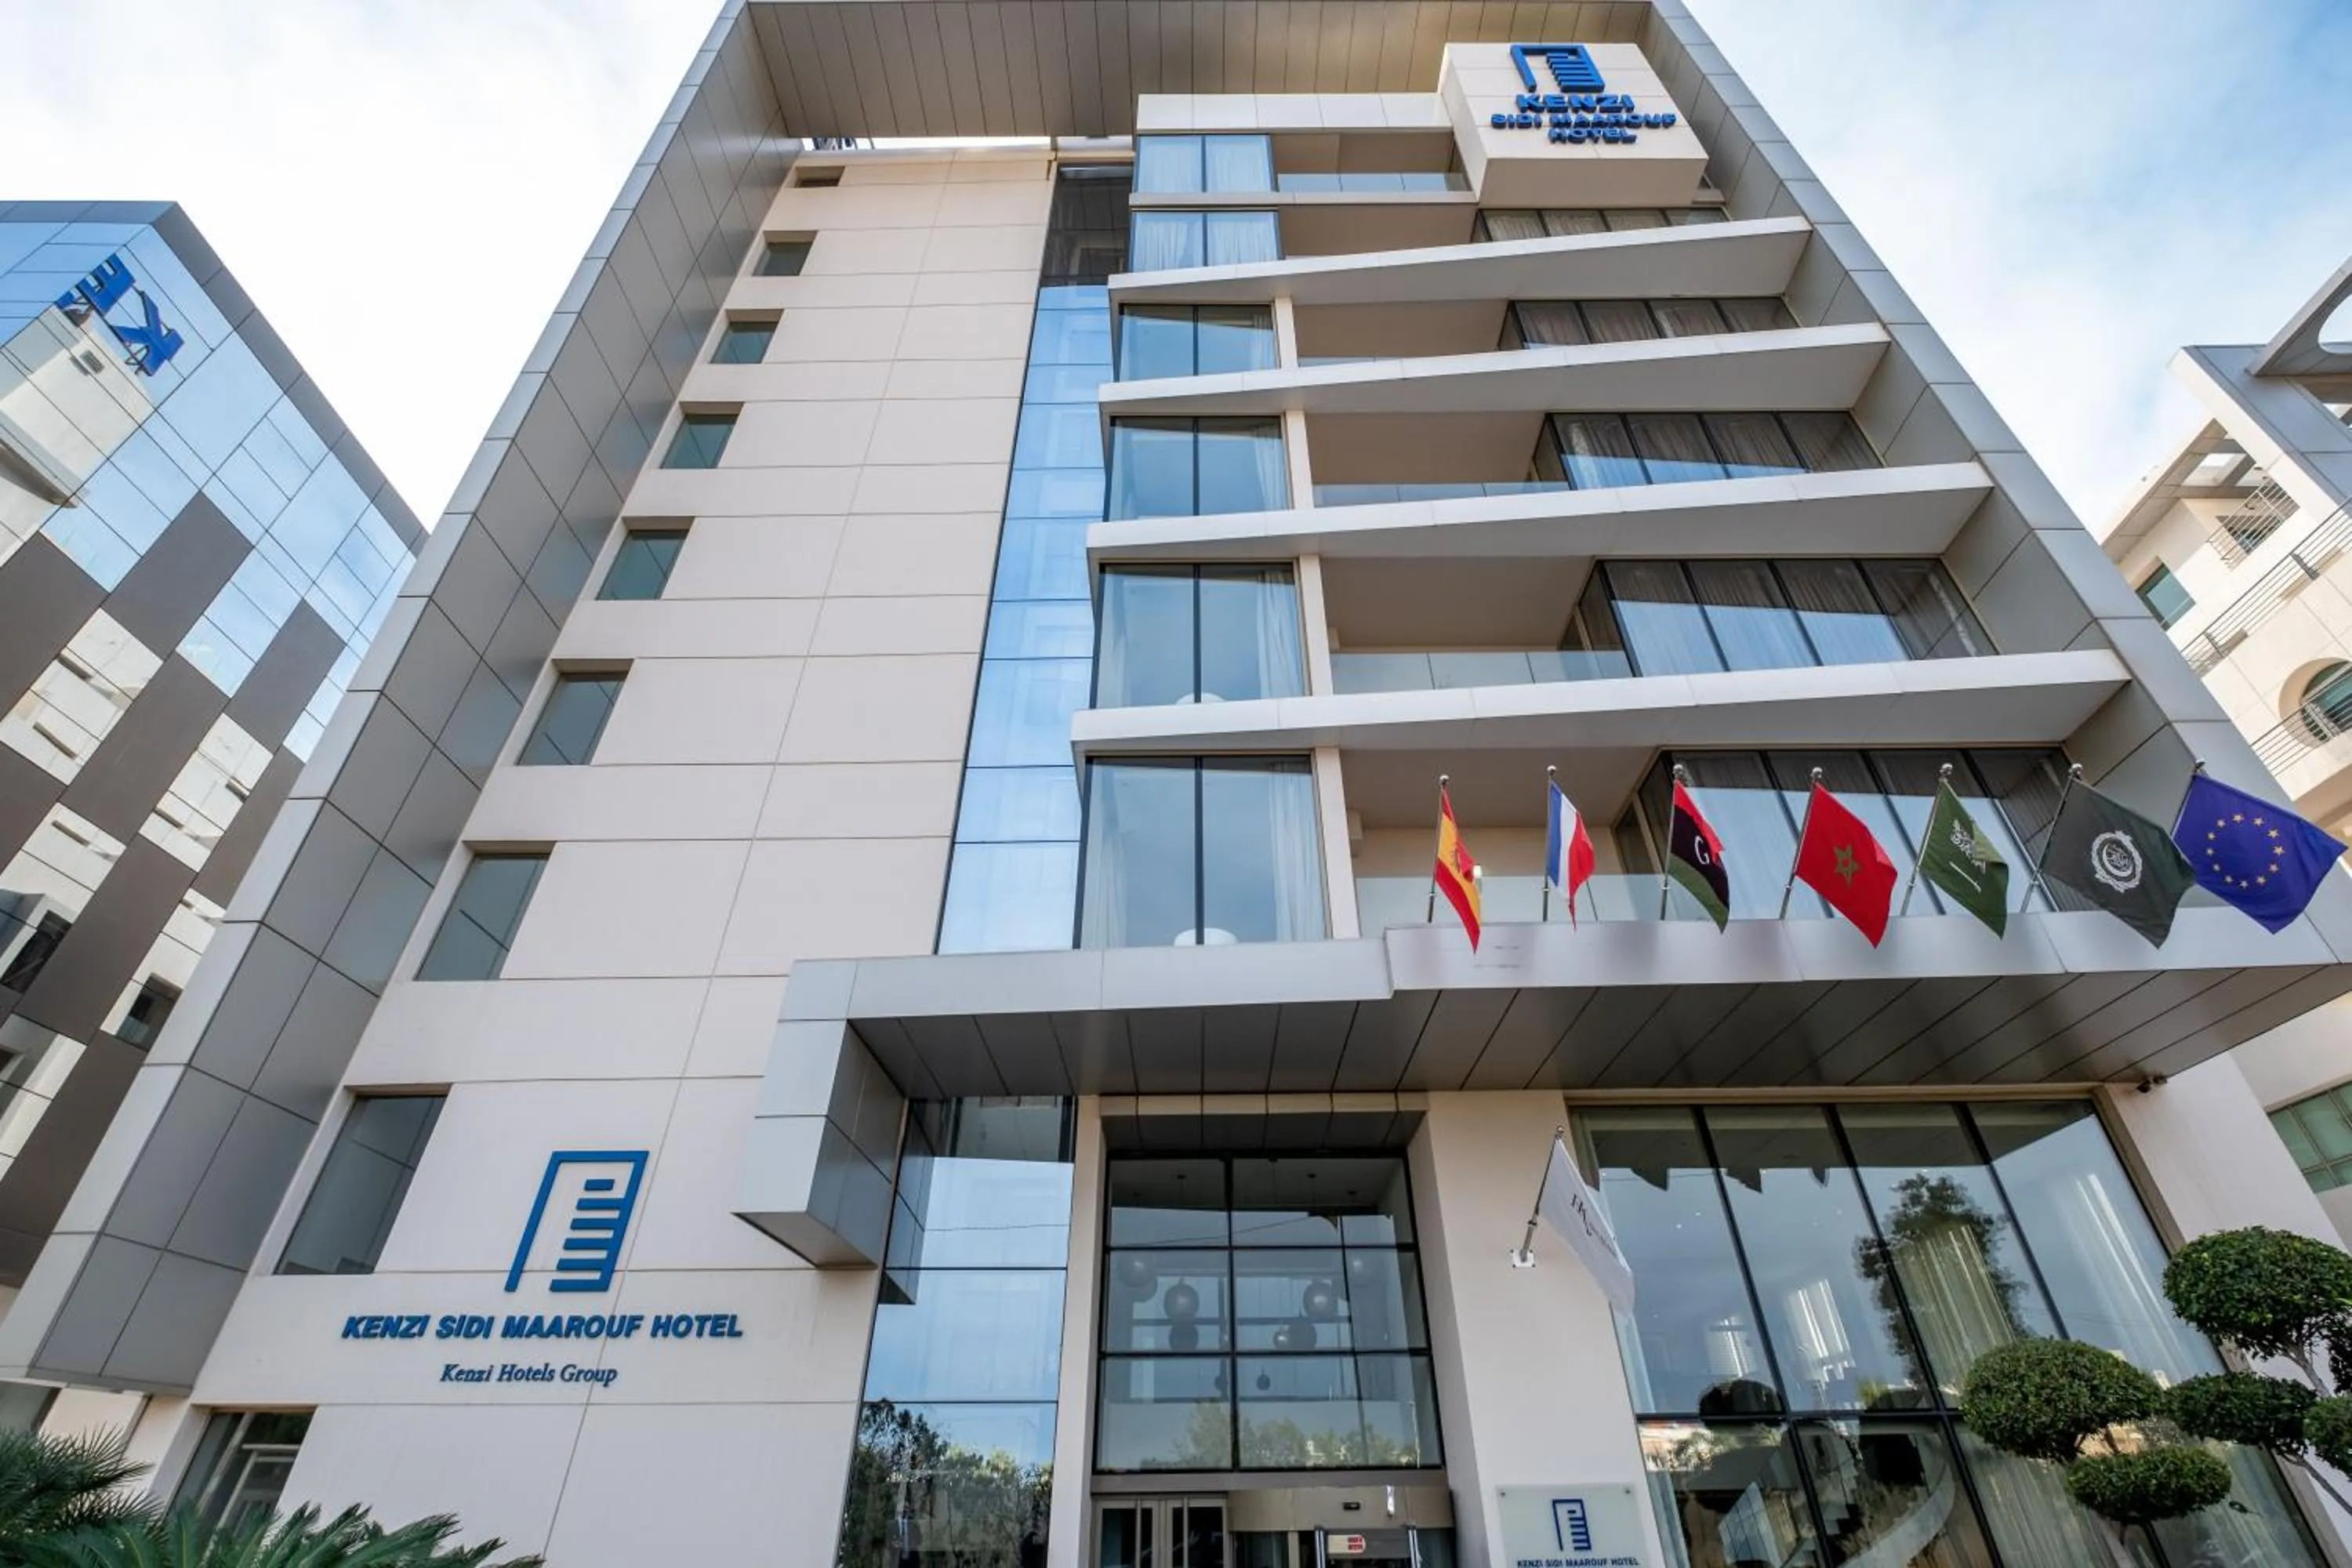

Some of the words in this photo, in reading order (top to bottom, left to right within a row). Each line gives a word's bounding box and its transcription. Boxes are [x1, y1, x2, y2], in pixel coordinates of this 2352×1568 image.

[1515, 94, 1635, 113] KENZI
[1491, 113, 1542, 129] SIDI
[1548, 113, 1676, 129] MAAROUF
[1548, 127, 1637, 144] HOTEL
[341, 1315, 430, 1339] KENZI
[436, 1314, 495, 1339] SIDI
[501, 1315, 644, 1338] MAAROUF
[650, 1314, 742, 1338] HOTEL
[440, 1363, 494, 1382] Kenzi
[496, 1363, 555, 1382] Hotels
[560, 1363, 618, 1388] Group
[1611, 1557, 1639, 1566] HOTEL
